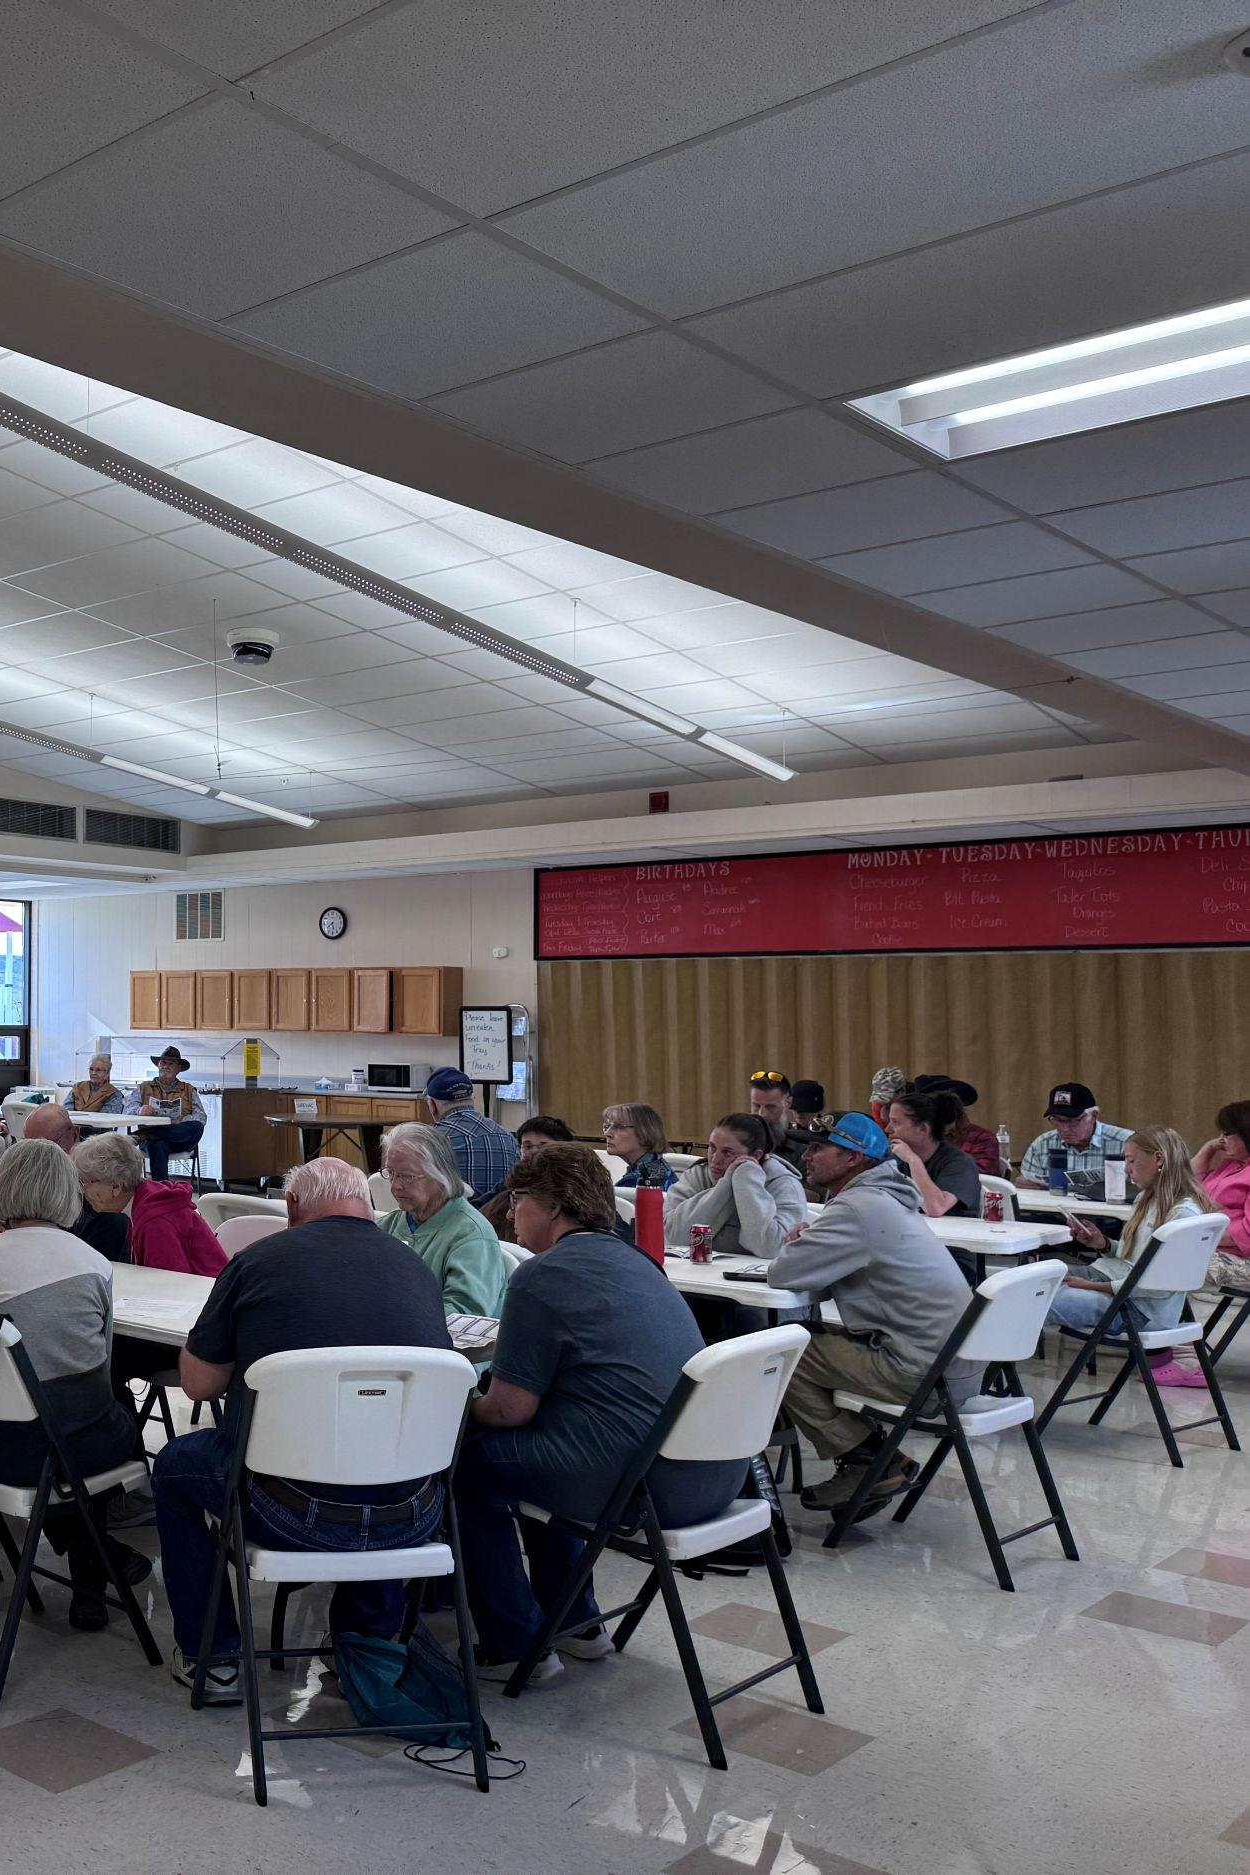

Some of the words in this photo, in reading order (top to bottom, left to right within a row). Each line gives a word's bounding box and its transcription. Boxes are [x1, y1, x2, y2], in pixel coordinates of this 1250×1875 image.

[847, 849, 924, 869] MONDAY
[940, 842, 1036, 864] TUESDAY
[1044, 832, 1183, 858] WEDNESDAY
[635, 861, 731, 881] BIRTHDAYS
[1199, 855, 1229, 873] Deli
[960, 867, 1004, 883] Pizza
[848, 874, 929, 896] Cheeseburger
[894, 894, 926, 912] Fries
[1202, 896, 1239, 914] Pasta
[971, 914, 1008, 928] Cream
[1062, 924, 1110, 938] Dessert
[464, 1011, 485, 1022] Please
